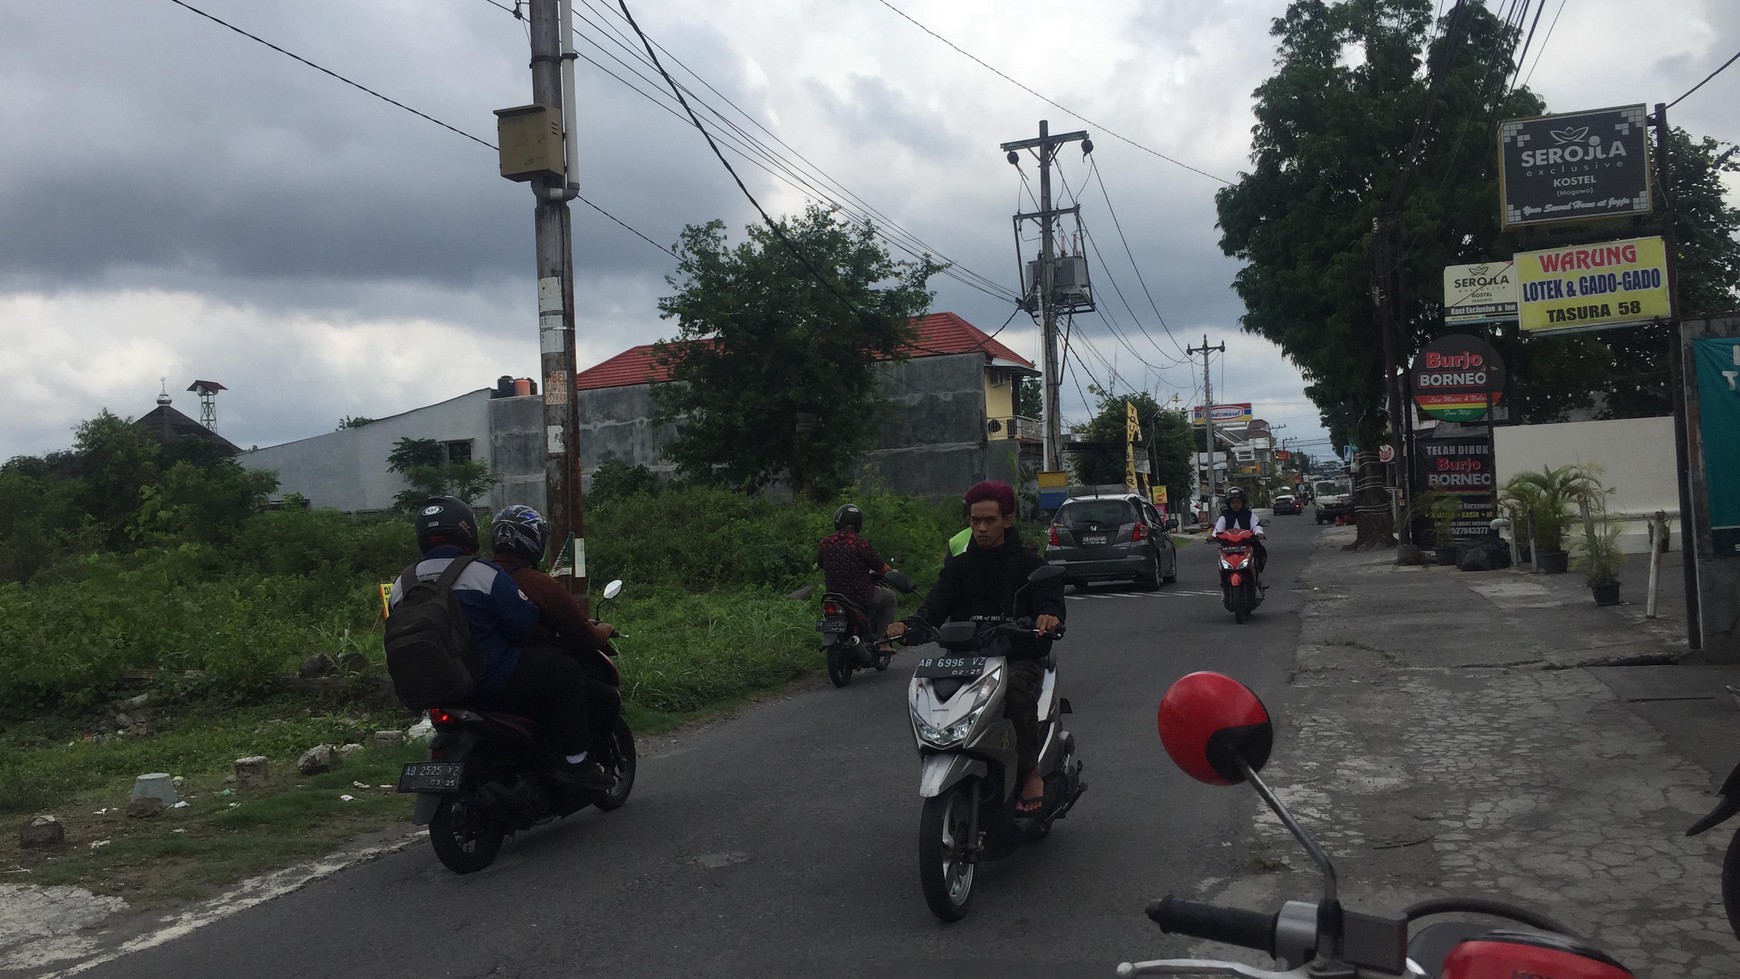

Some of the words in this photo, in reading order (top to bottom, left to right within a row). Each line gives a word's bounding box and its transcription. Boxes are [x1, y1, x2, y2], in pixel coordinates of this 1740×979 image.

[1526, 161, 1623, 177] exclusive
[1553, 175, 1597, 188] KOSTEL
[1556, 187, 1594, 198] (Maguwo)
[1522, 205, 1542, 216] Your
[1543, 201, 1572, 213] Second
[1572, 200, 1596, 209] Home
[1597, 199, 1607, 207] at
[1538, 244, 1637, 274] WARUNG
[1522, 279, 1564, 303] LOTEK
[1565, 280, 1576, 298] &
[1579, 268, 1661, 297] GADO-GADO
[1450, 307, 1465, 316] Kost
[1466, 304, 1496, 314] Exclusive
[1498, 304, 1503, 312] &
[1546, 303, 1611, 324] TASURA
[1618, 300, 1641, 316] 58
[1425, 350, 1483, 370] Burjo
[1419, 372, 1487, 387] BORNEO
[1426, 445, 1456, 456] TELAH
[1458, 444, 1490, 455] DIBUK
[1436, 457, 1481, 472] Burjo
[1428, 473, 1491, 486] BORNEO
[919, 658, 932, 668] AB
[937, 658, 965, 668] 6996
[972, 656, 986, 666] VZ
[405, 765, 417, 776] AB
[419, 765, 443, 776] 2525
